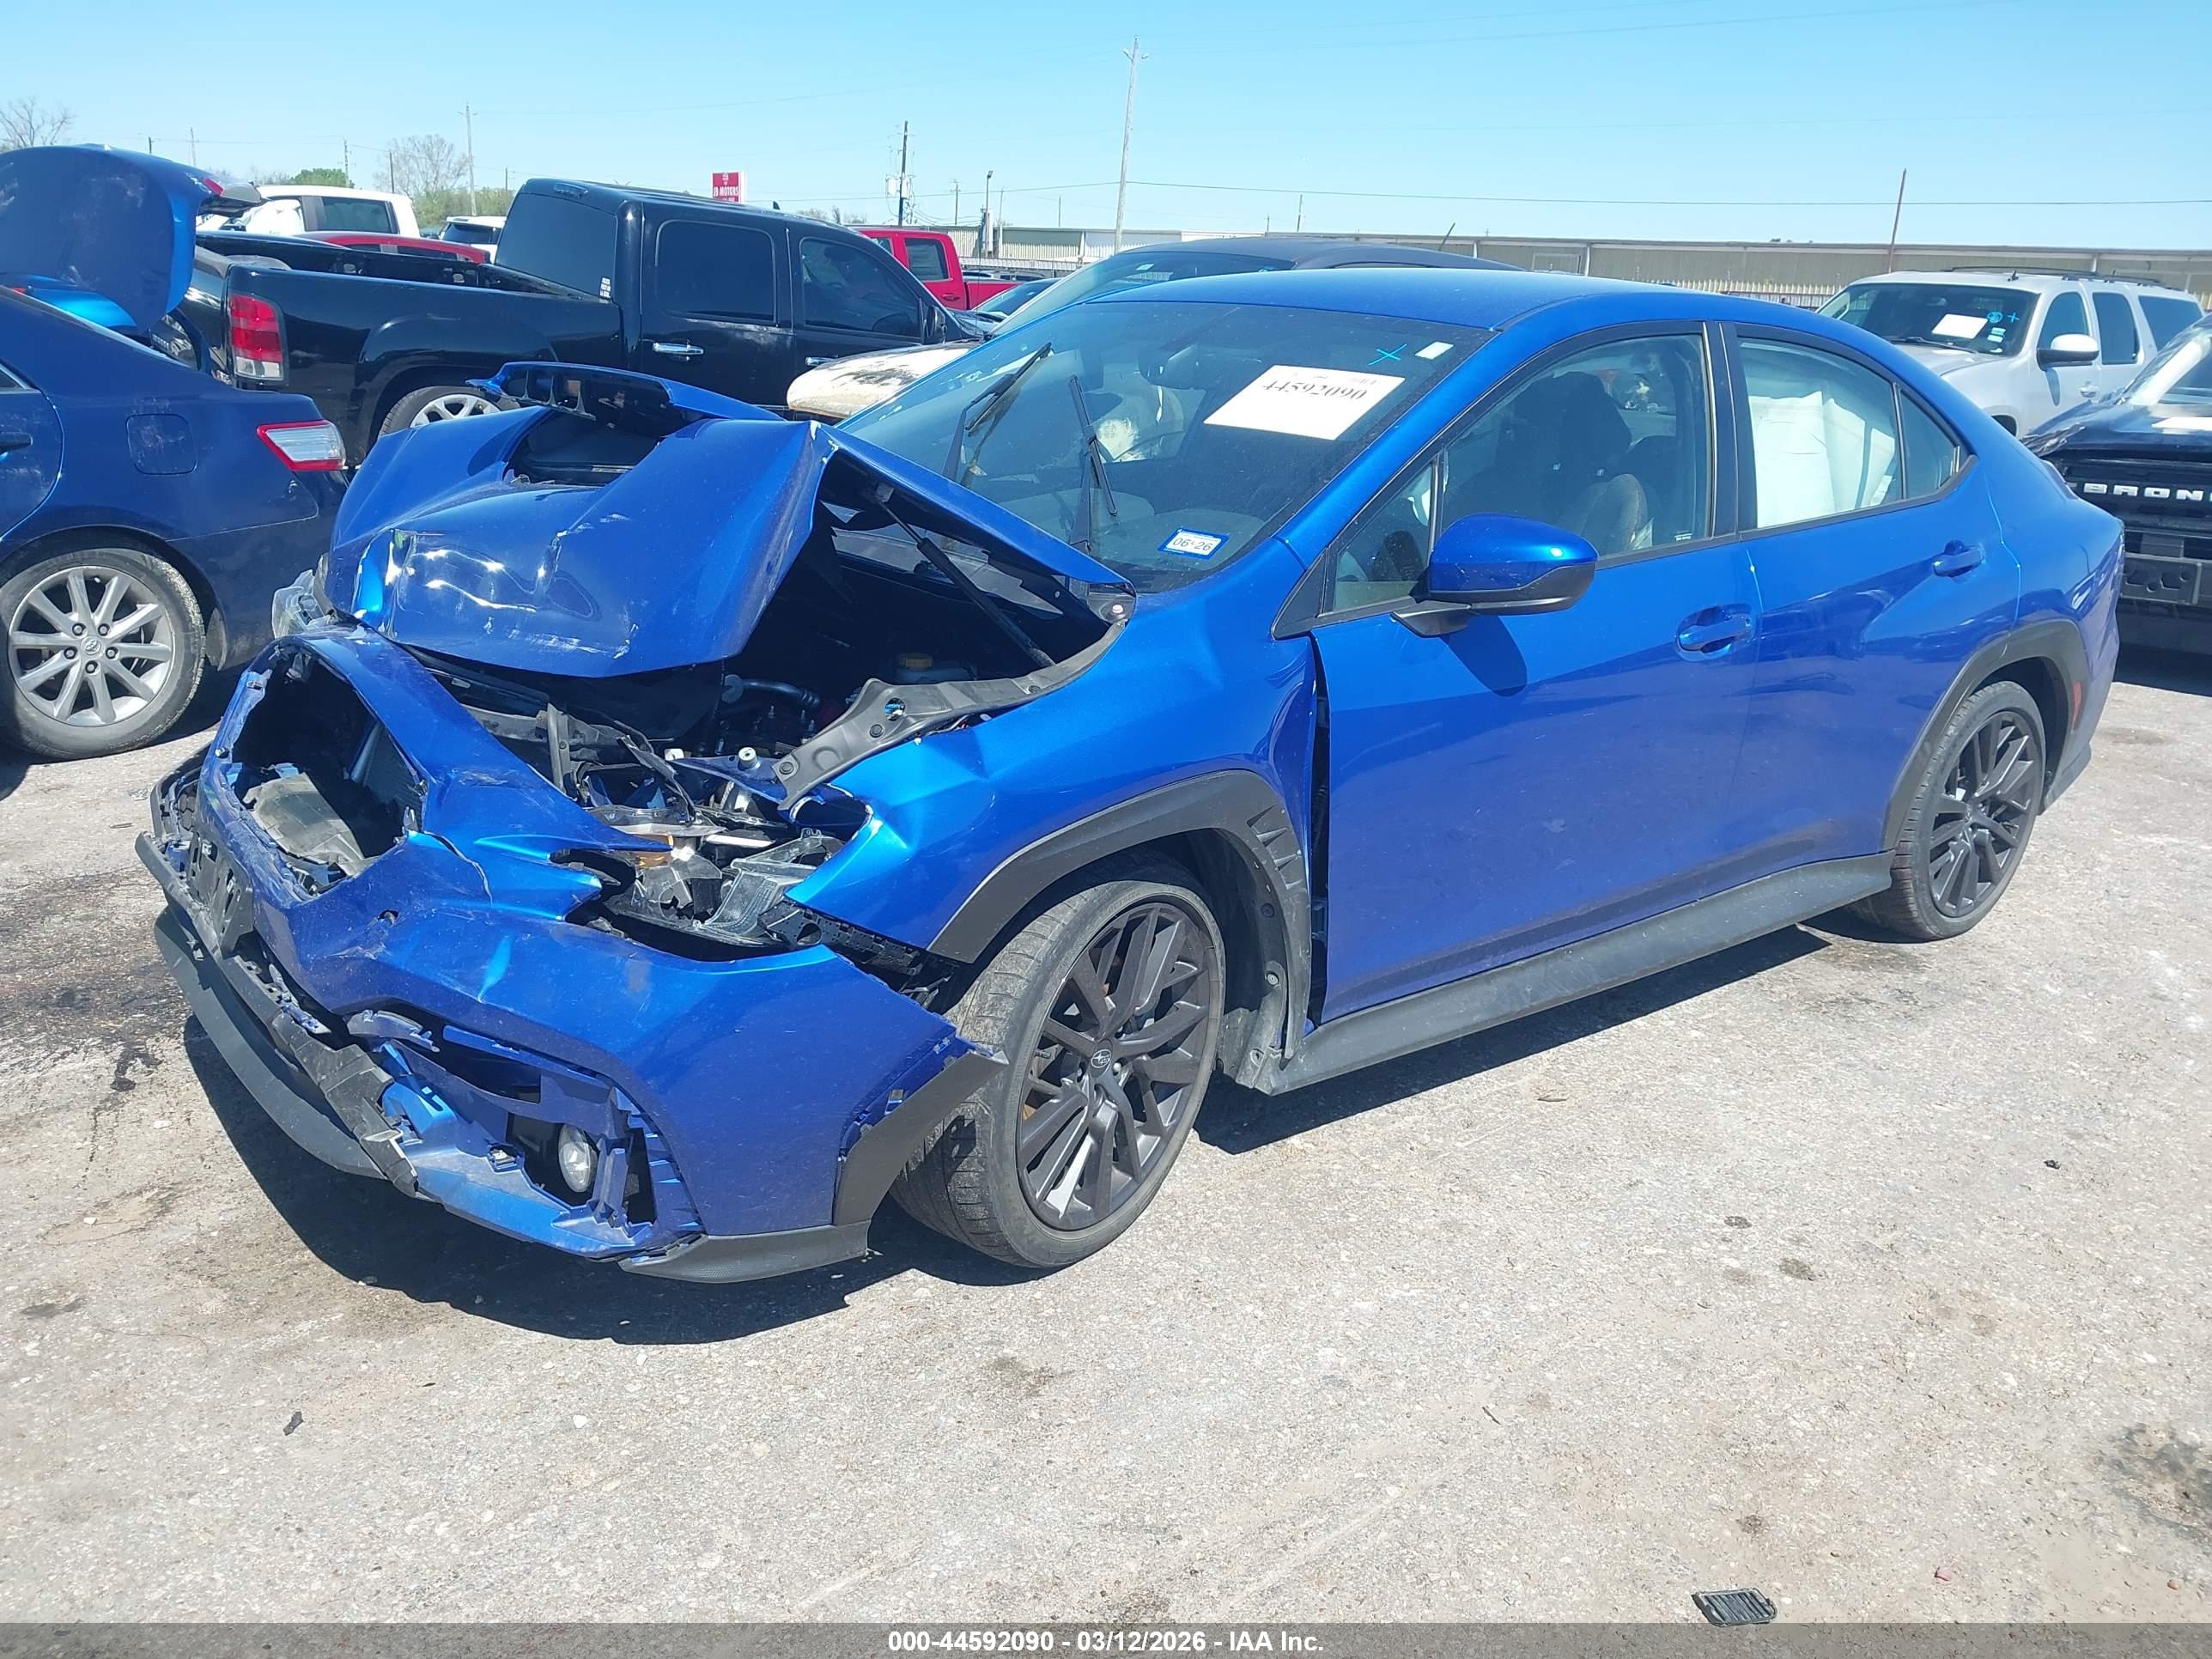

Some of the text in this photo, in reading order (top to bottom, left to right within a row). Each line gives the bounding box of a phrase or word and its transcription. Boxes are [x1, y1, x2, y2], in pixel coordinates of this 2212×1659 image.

[719, 185, 738, 197] MOTORS
[1262, 380, 1368, 400] 44592090
[2083, 483, 2212, 501] BRON
